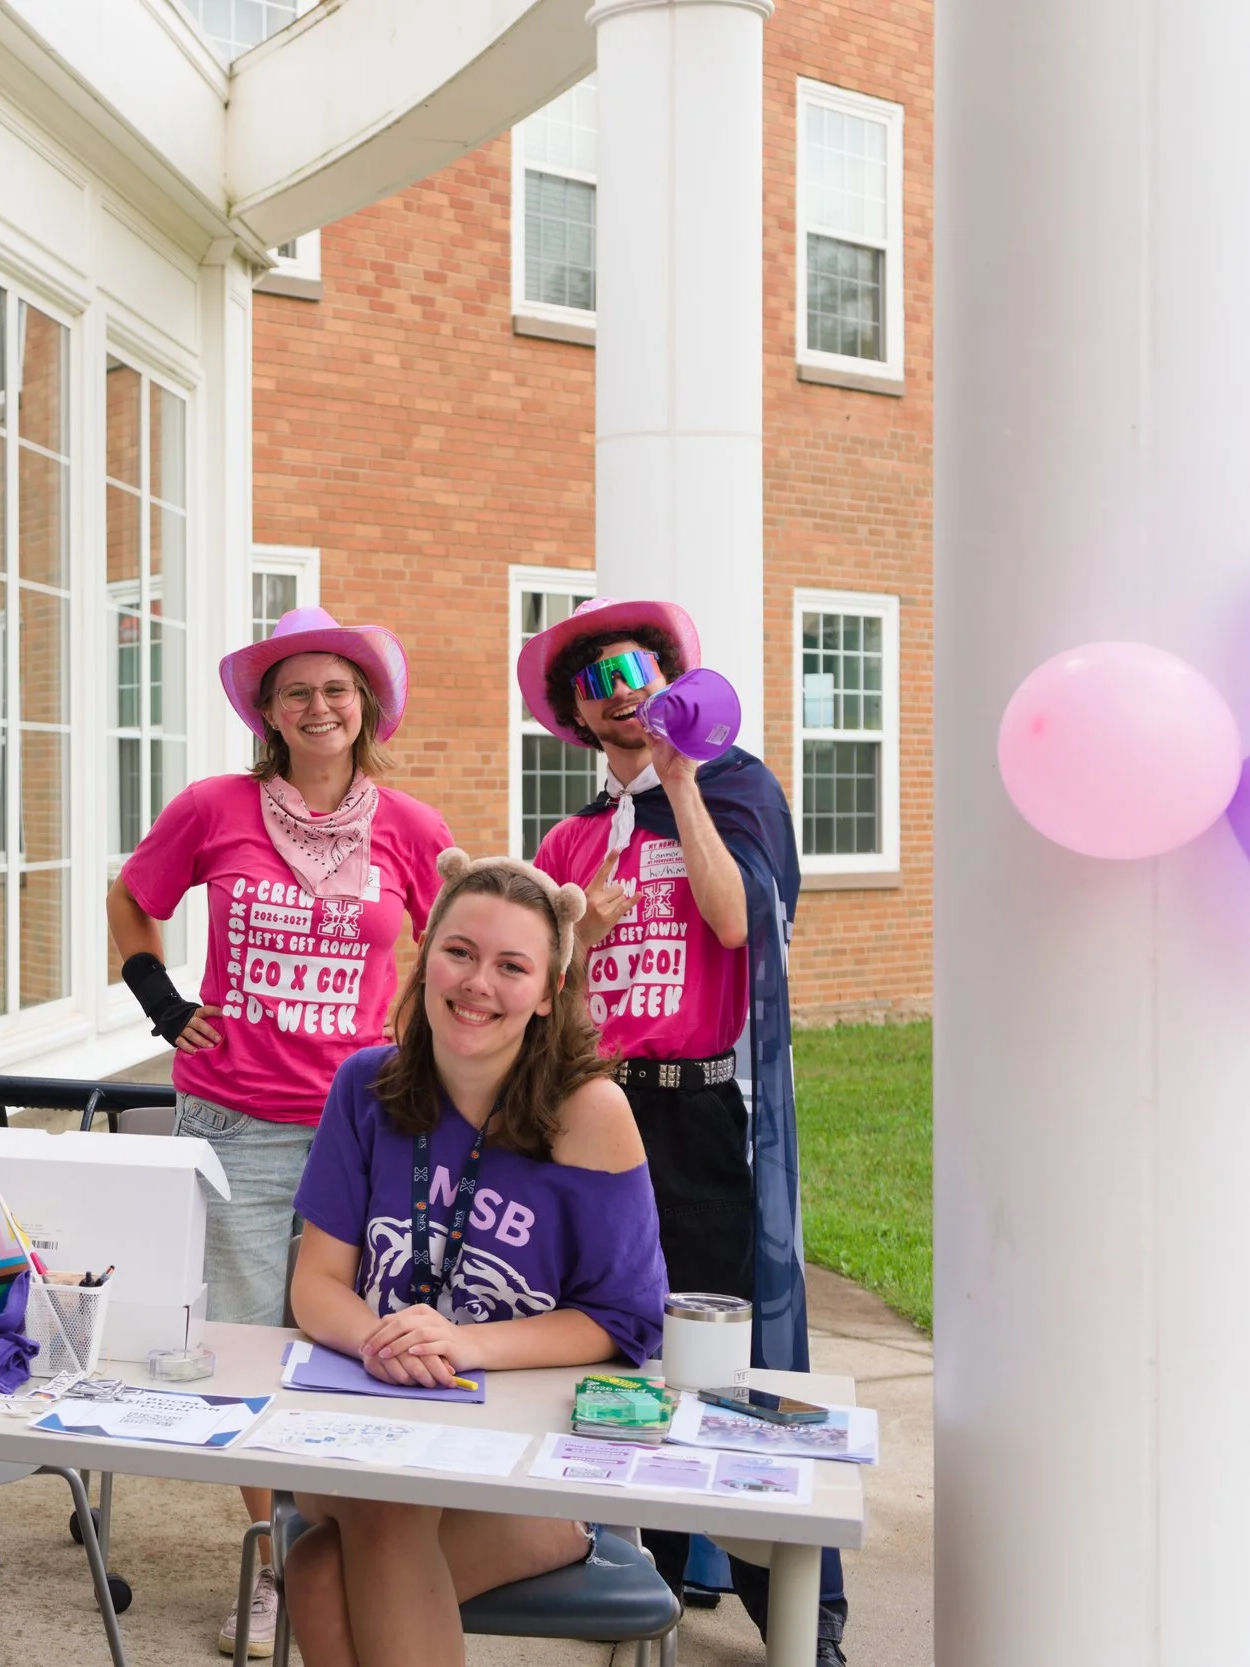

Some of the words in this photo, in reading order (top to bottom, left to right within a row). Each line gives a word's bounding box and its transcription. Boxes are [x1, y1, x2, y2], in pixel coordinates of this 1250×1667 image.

[232, 878, 316, 908] O-CREW
[254, 911, 307, 926] 2026-2027
[619, 926, 644, 942] GET
[646, 922, 687, 937] OWDY
[222, 902, 247, 1019] XAVERIAN
[248, 930, 284, 949] LET'S
[289, 935, 316, 953] GET
[320, 939, 370, 957] ROWDY
[249, 958, 281, 987] GO
[291, 964, 308, 990] X
[317, 968, 359, 994] GO!
[592, 954, 618, 983] GO
[642, 948, 681, 975] GO!
[247, 995, 357, 1035] O-WEEK
[428, 1165, 536, 1248] MSB
